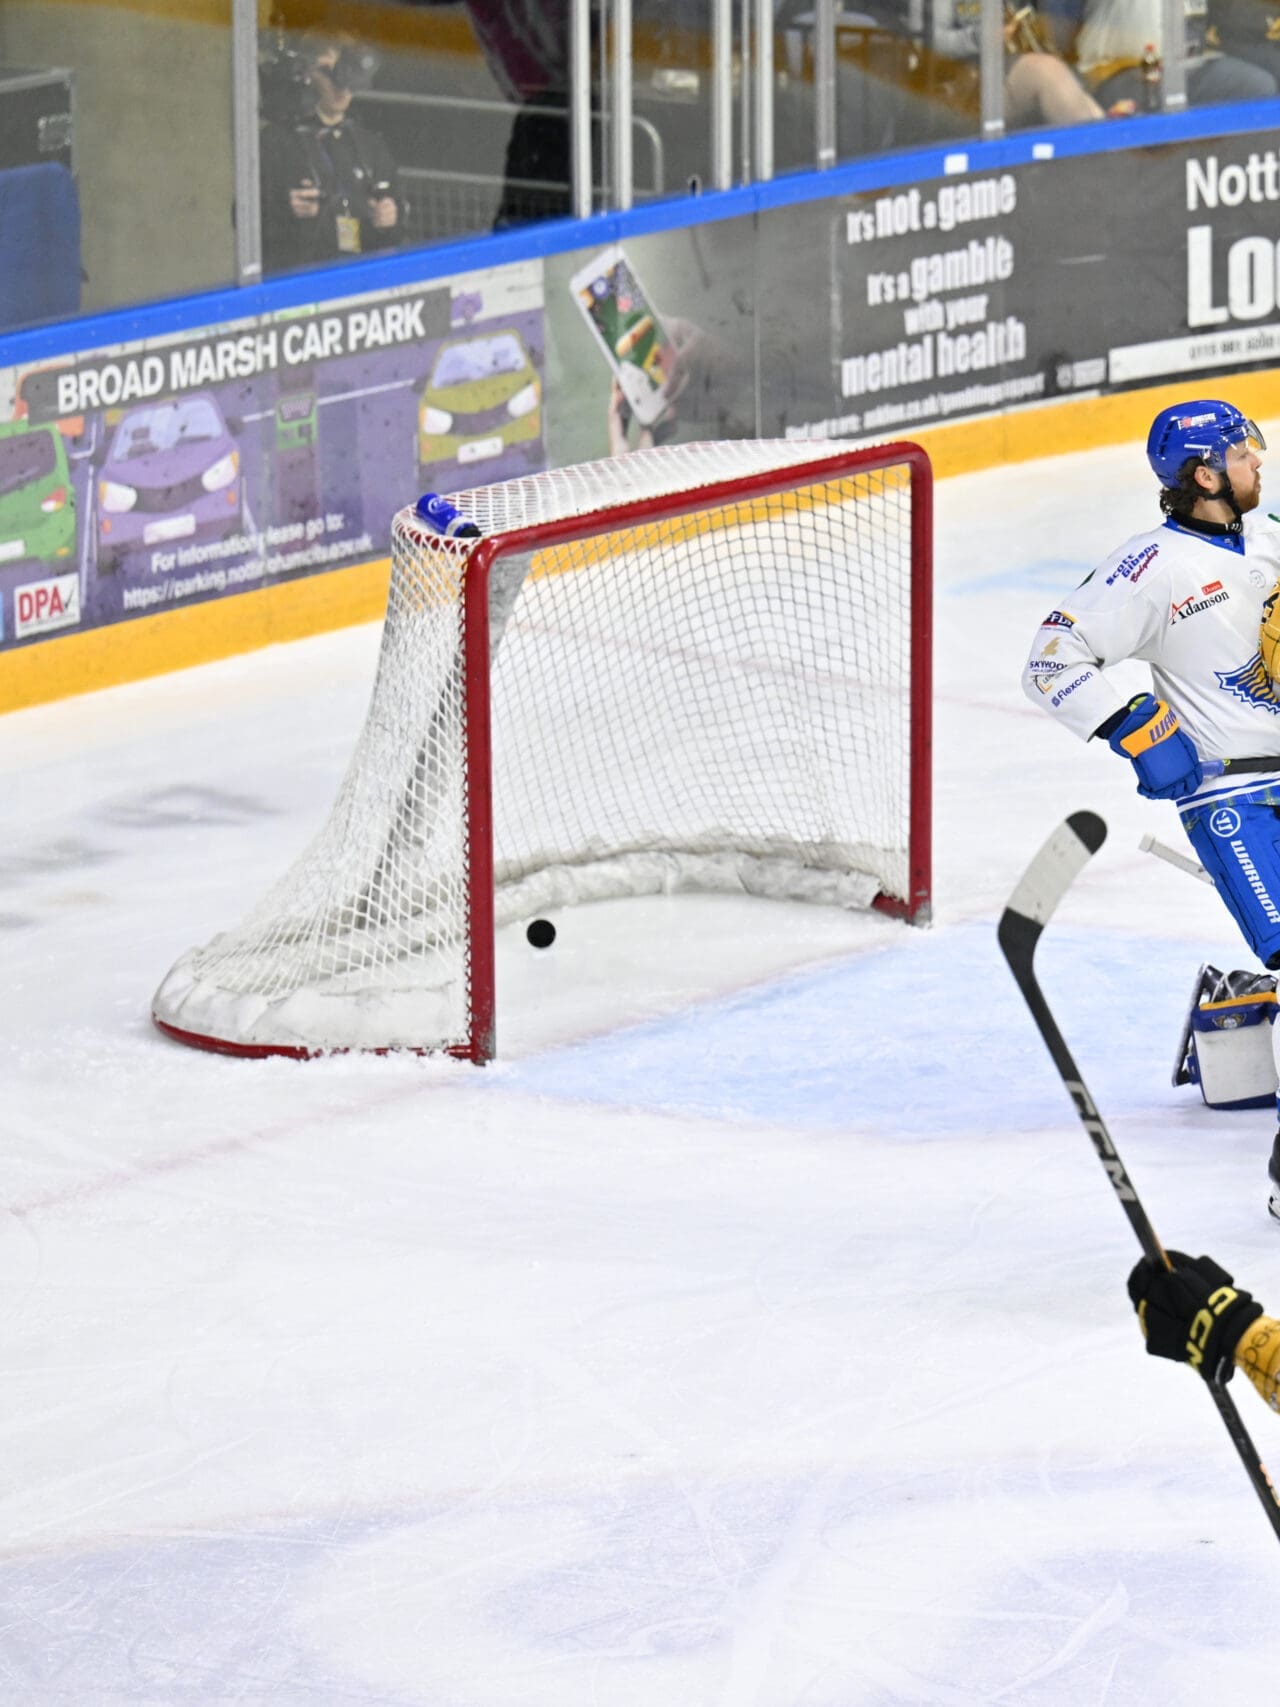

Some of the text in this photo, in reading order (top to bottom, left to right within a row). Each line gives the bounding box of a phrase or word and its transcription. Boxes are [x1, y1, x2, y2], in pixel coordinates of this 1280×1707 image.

[875, 188, 921, 239] not
[923, 201, 937, 229] a
[938, 174, 1016, 231] game
[896, 272, 910, 300] a
[910, 235, 1014, 302] gamble
[945, 294, 989, 331] your
[57, 300, 426, 415] BROAD MARSH CAR PARK
[841, 334, 933, 398] mental
[936, 316, 1026, 378] health
[151, 551, 176, 574] For
[306, 516, 325, 538] go
[1105, 553, 1135, 586] Scott
[1121, 542, 1160, 578] Gibson
[18, 584, 65, 623] DPA
[1168, 590, 1230, 626] Adamson
[1064, 1080, 1138, 1201] CCM
